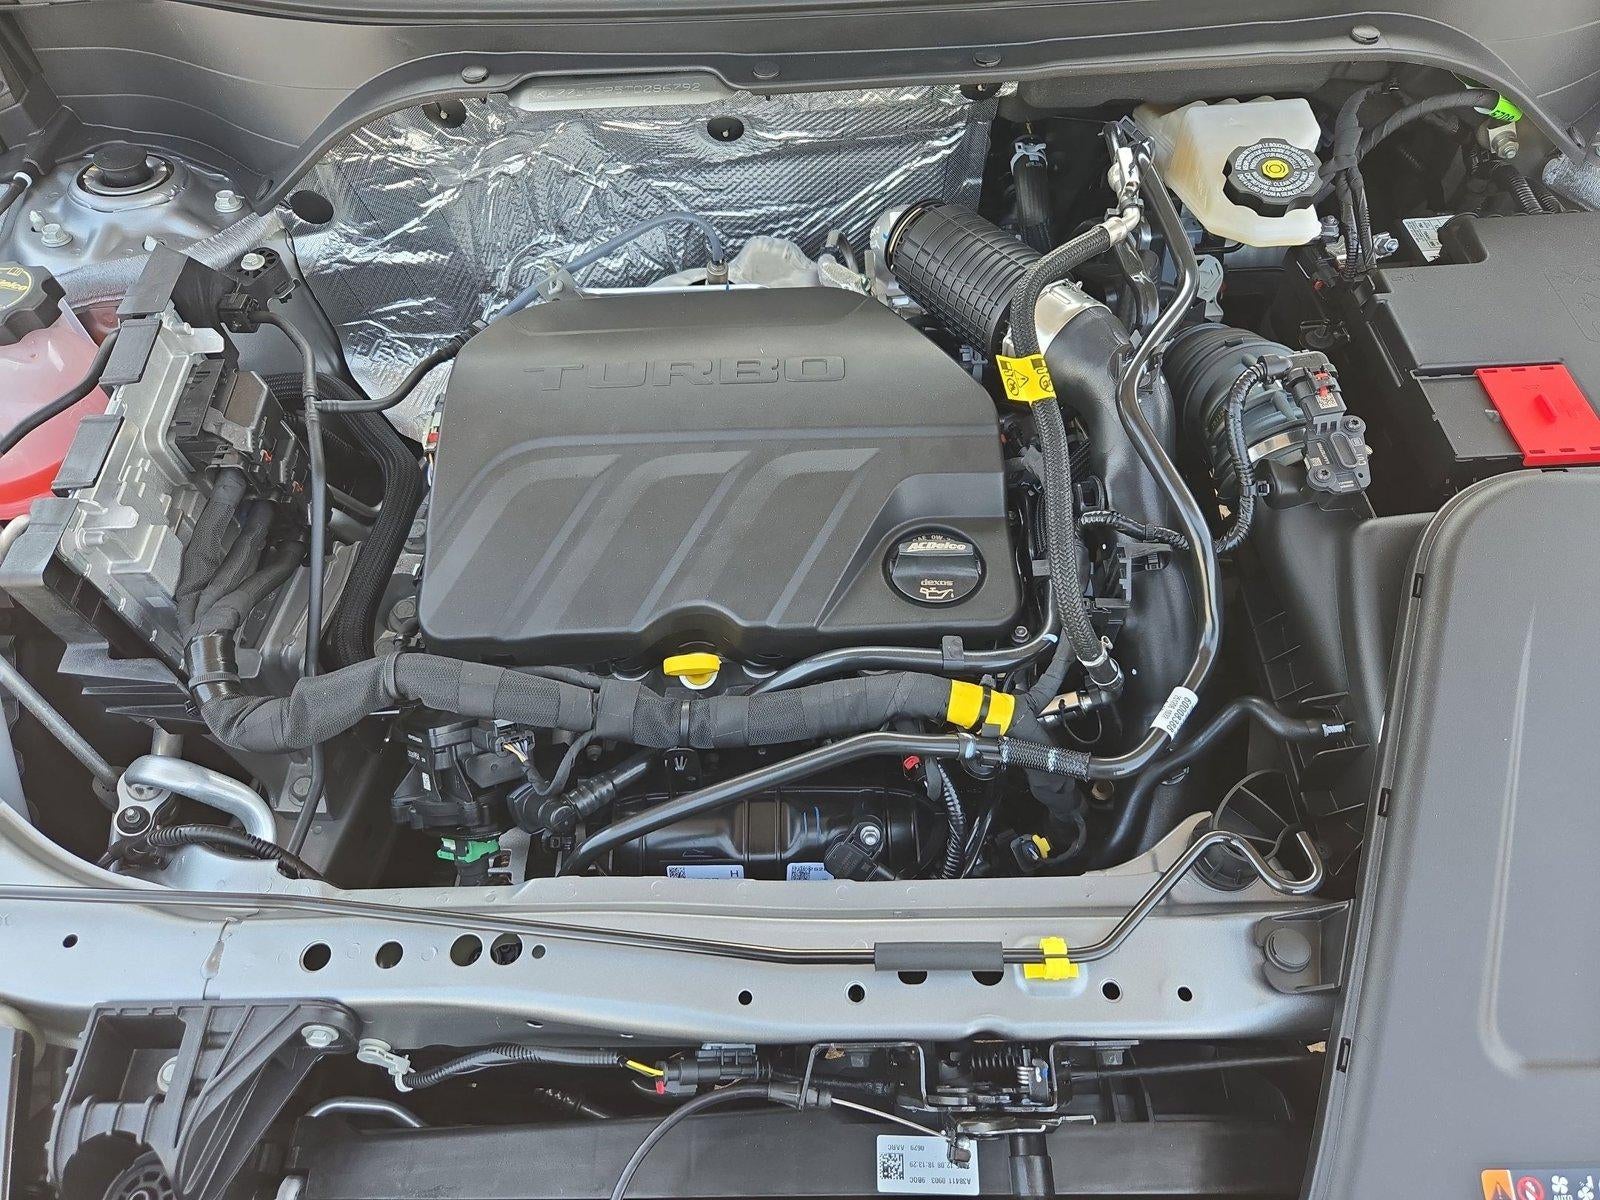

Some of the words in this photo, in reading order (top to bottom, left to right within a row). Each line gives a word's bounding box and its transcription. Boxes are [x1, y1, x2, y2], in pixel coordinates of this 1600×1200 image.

[523, 355, 847, 391] TURBO
[907, 541, 967, 552] ACDelco
[921, 578, 954, 586] dexos
